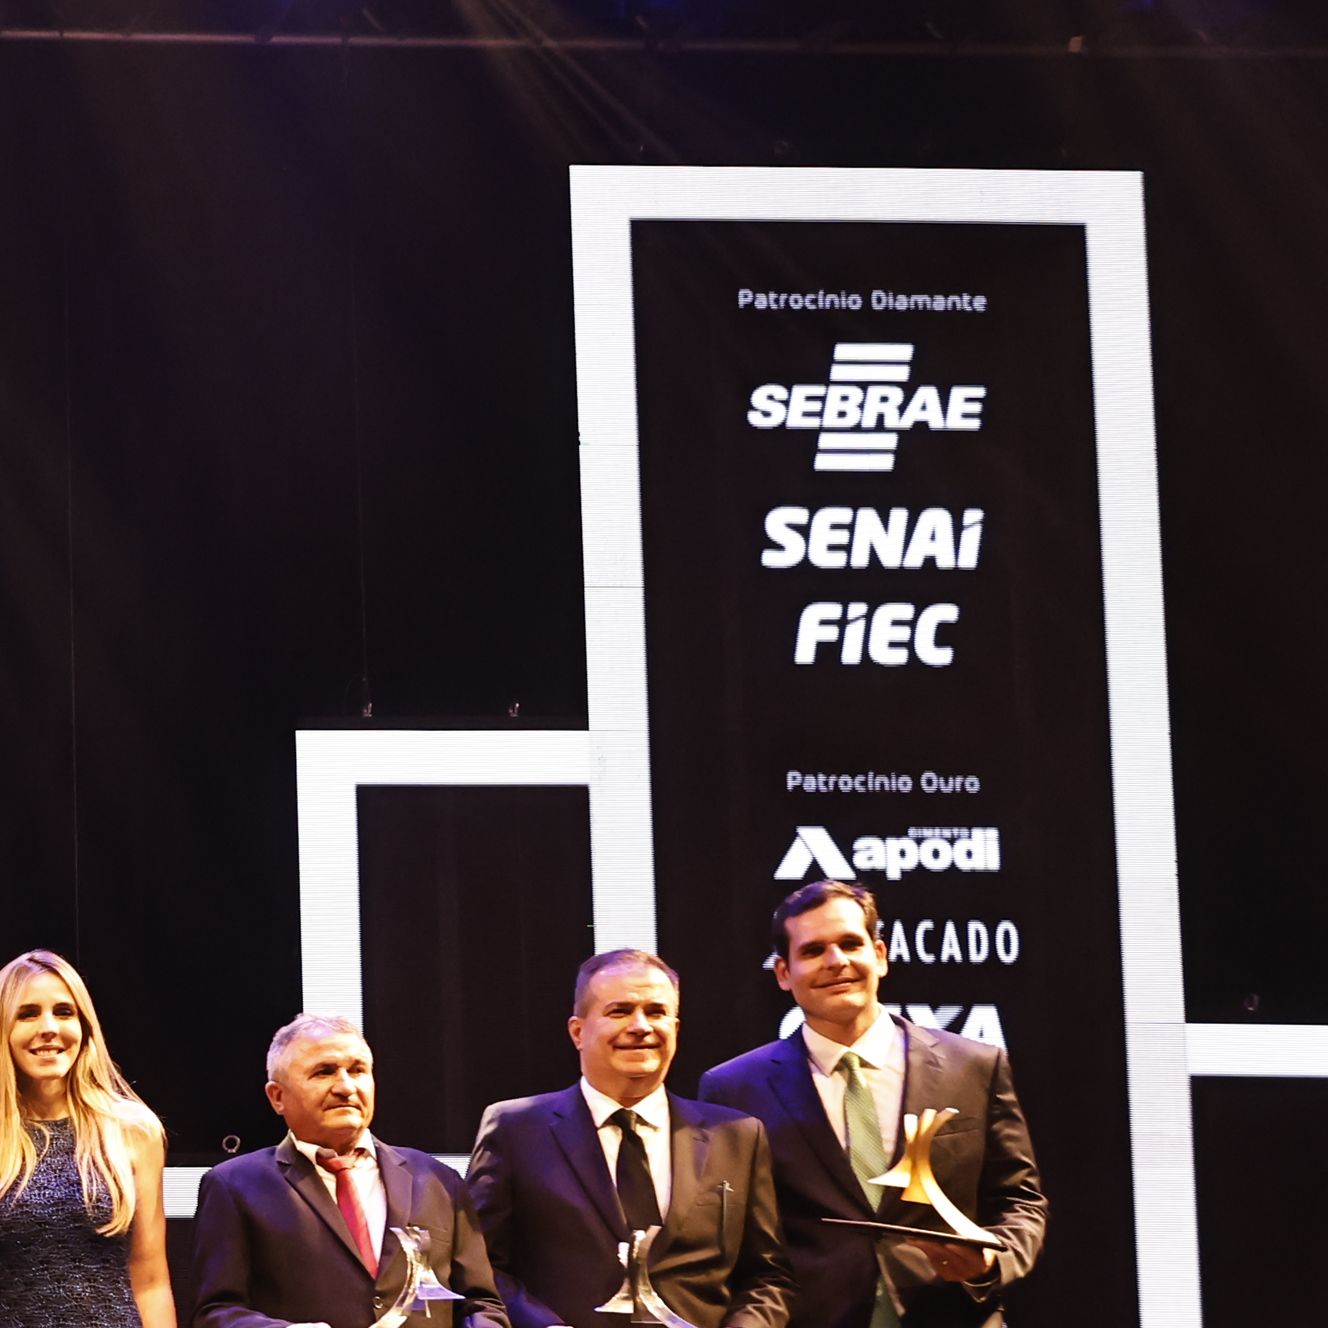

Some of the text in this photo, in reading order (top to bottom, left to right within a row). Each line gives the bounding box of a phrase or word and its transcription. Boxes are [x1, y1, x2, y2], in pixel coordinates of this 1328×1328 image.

[738, 289, 987, 311] Patrocínio Diamante
[747, 384, 987, 431] SEBRAE
[787, 771, 980, 793] Patrocínio Ouro
[876, 919, 1020, 964] ACADO
